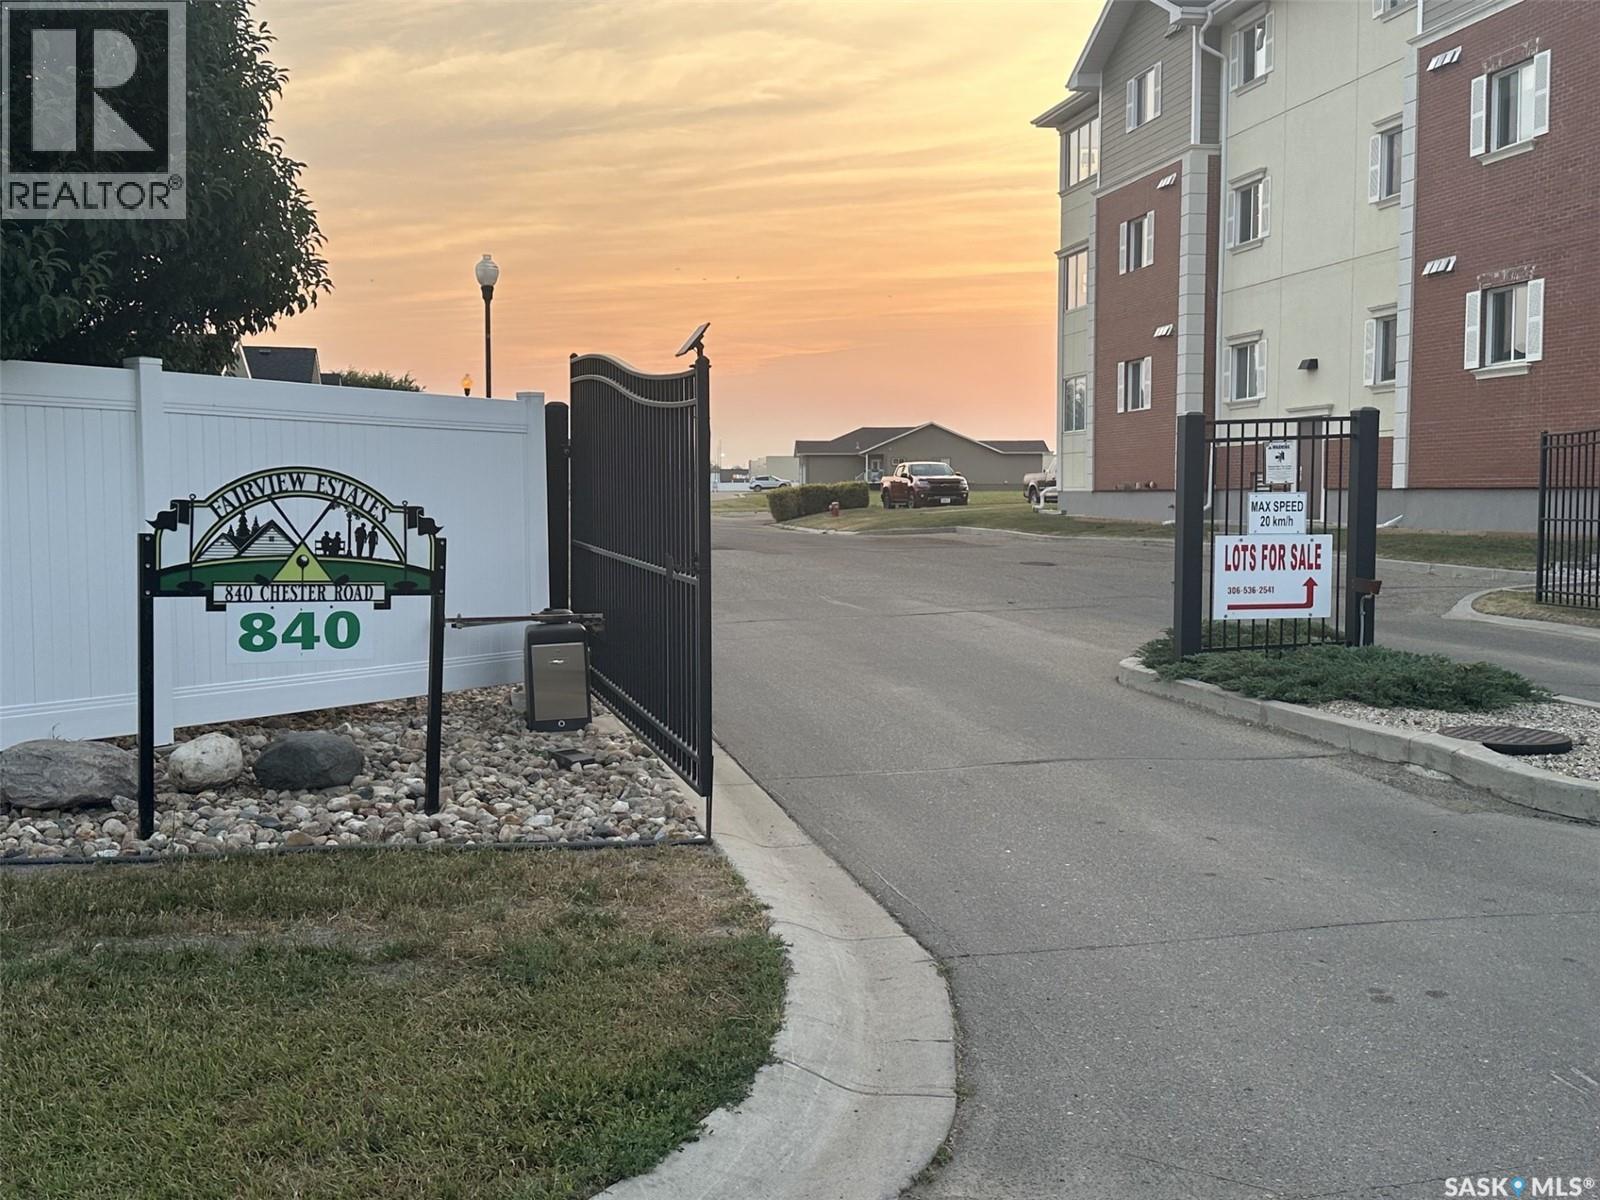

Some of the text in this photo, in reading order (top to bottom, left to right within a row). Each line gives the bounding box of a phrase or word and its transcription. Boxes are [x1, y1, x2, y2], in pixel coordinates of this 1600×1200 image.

[210, 472, 391, 524] FAIRVIEW ESTATES
[1251, 501, 1304, 512] MAX SPEED
[1260, 516, 1294, 527] 20 km/h
[1225, 543, 1322, 571] LOTS FOR SALE
[225, 584, 374, 601] 840 CHESTER ROAD
[1227, 586, 1275, 595] 306-536-2541
[238, 611, 361, 652] 840
